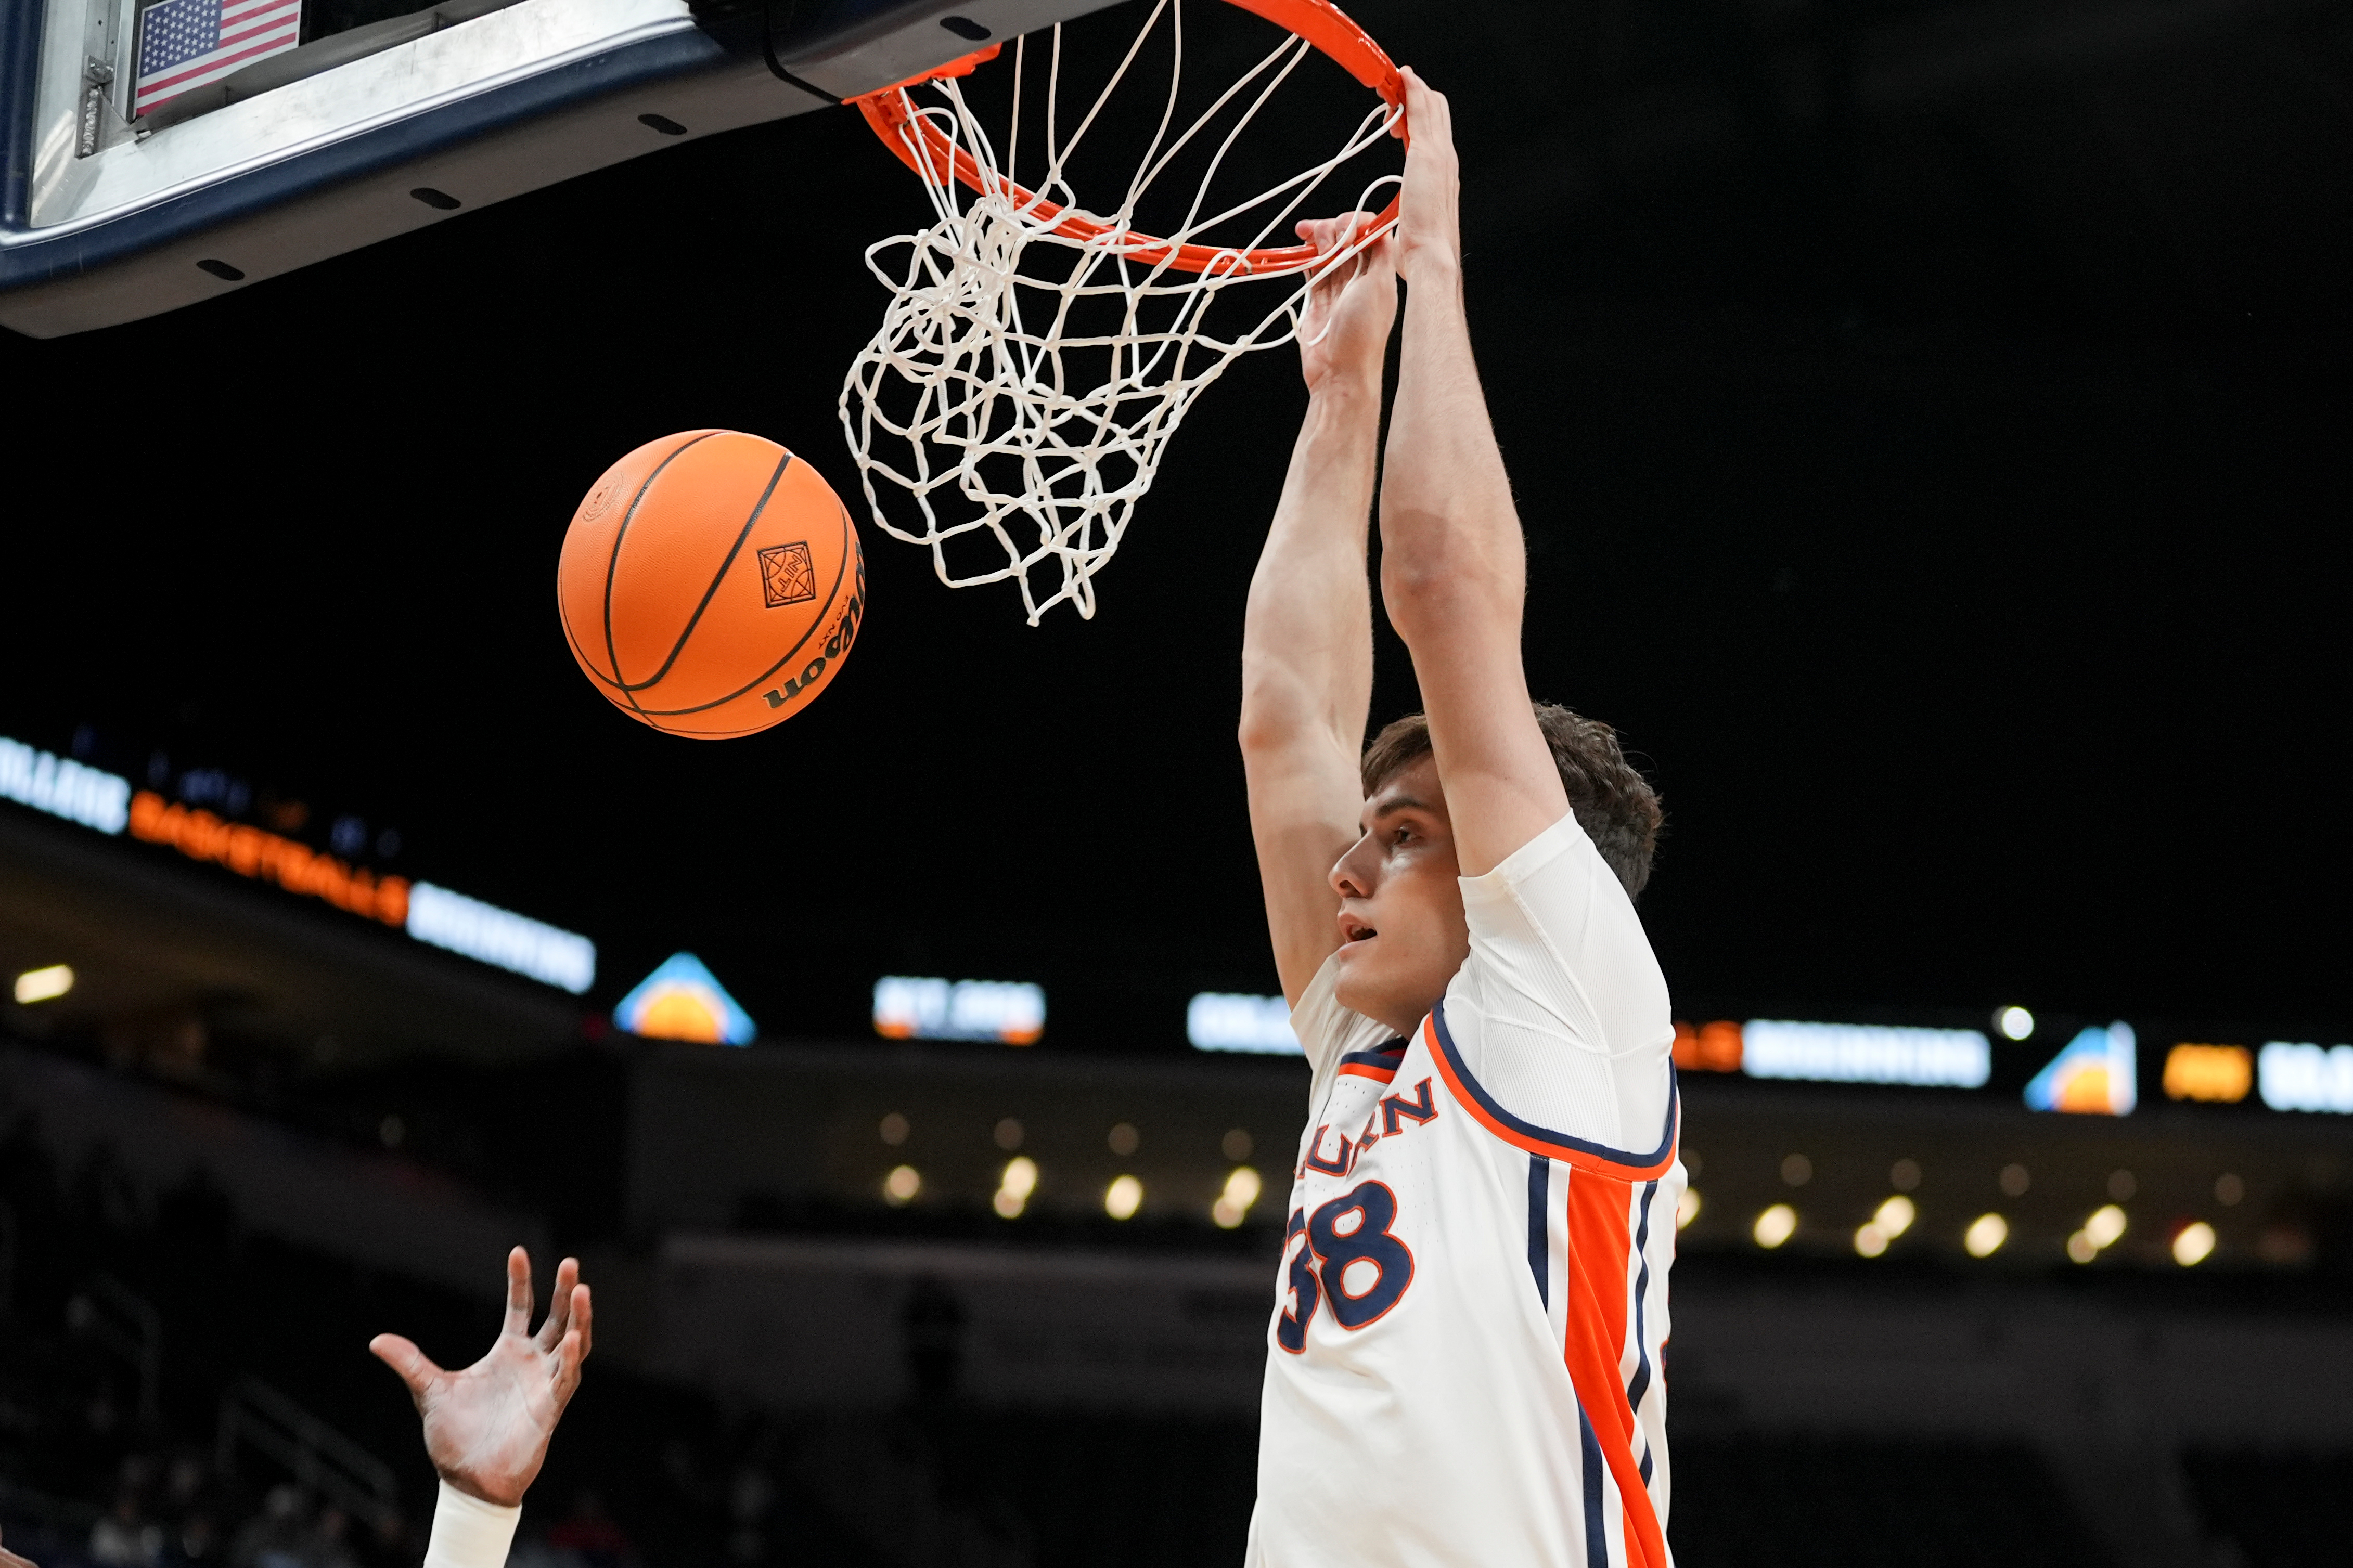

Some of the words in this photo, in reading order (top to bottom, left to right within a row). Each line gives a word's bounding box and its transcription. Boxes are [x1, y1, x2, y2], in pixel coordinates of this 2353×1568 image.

[778, 554, 803, 594] NIT
[818, 624, 835, 650] NXT
[1277, 1179, 1415, 1355] 38
